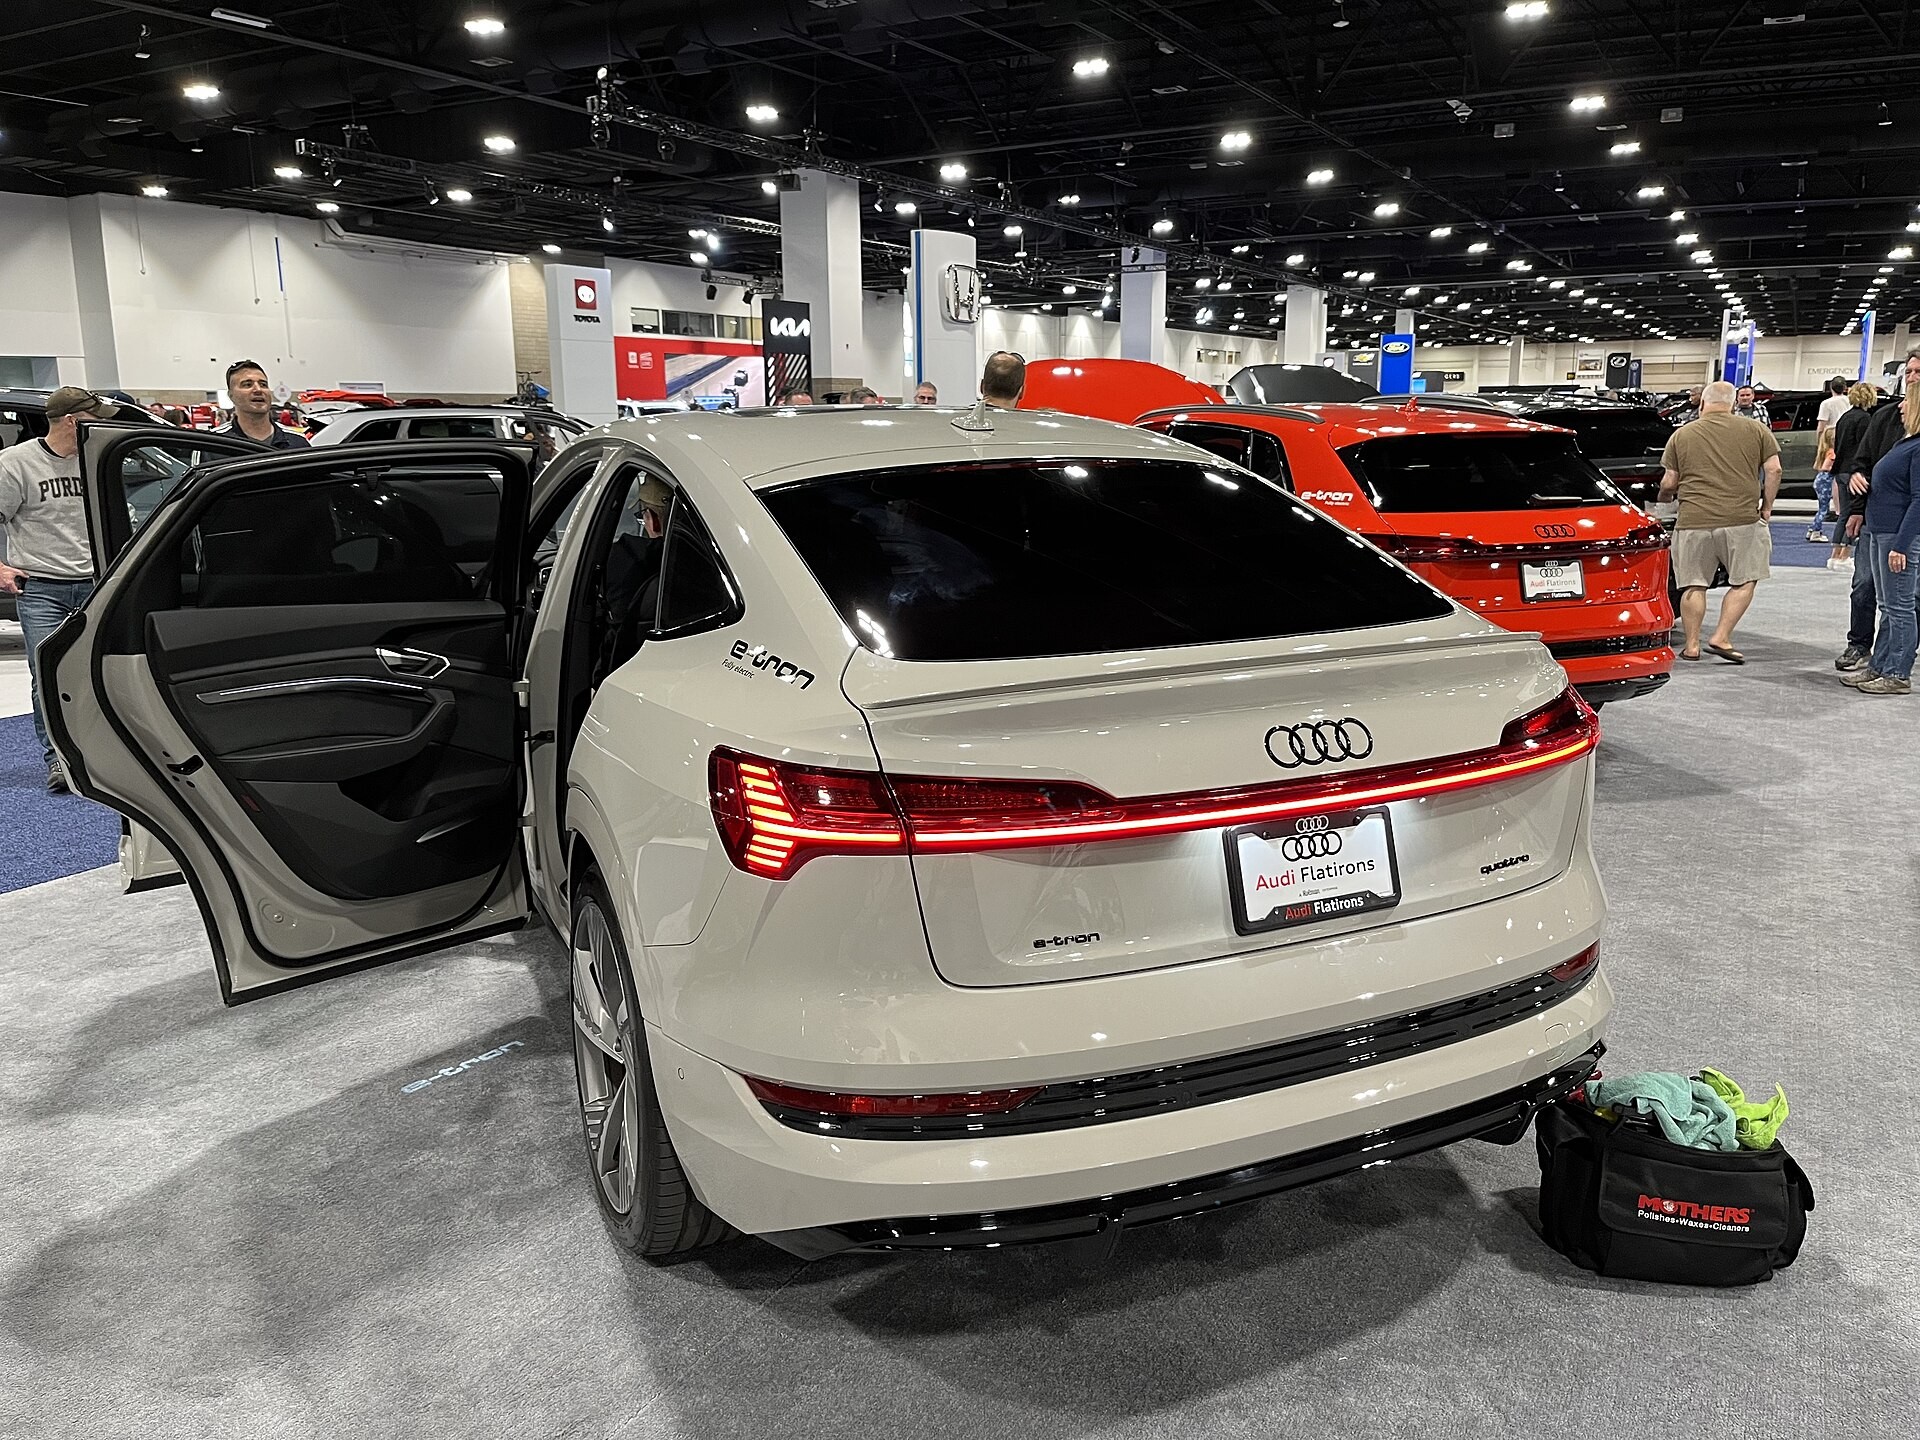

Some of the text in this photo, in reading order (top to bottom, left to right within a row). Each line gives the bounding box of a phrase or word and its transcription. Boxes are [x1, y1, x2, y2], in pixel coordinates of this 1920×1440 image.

[573, 315, 600, 323] TOYOTA
[1807, 367, 1854, 375] EMERGENCY
[1301, 490, 1354, 502] e-tron
[1546, 579, 1576, 587] Flatirons
[729, 639, 815, 690] e-tron
[1256, 858, 1375, 891] Audi Flatirons
[1480, 854, 1530, 875] quattro
[1286, 895, 1364, 920] Audi Flatirons
[1033, 932, 1101, 949] e-tron
[400, 1041, 525, 1094] e-tron
[1637, 1194, 1750, 1224] MOTHERS
